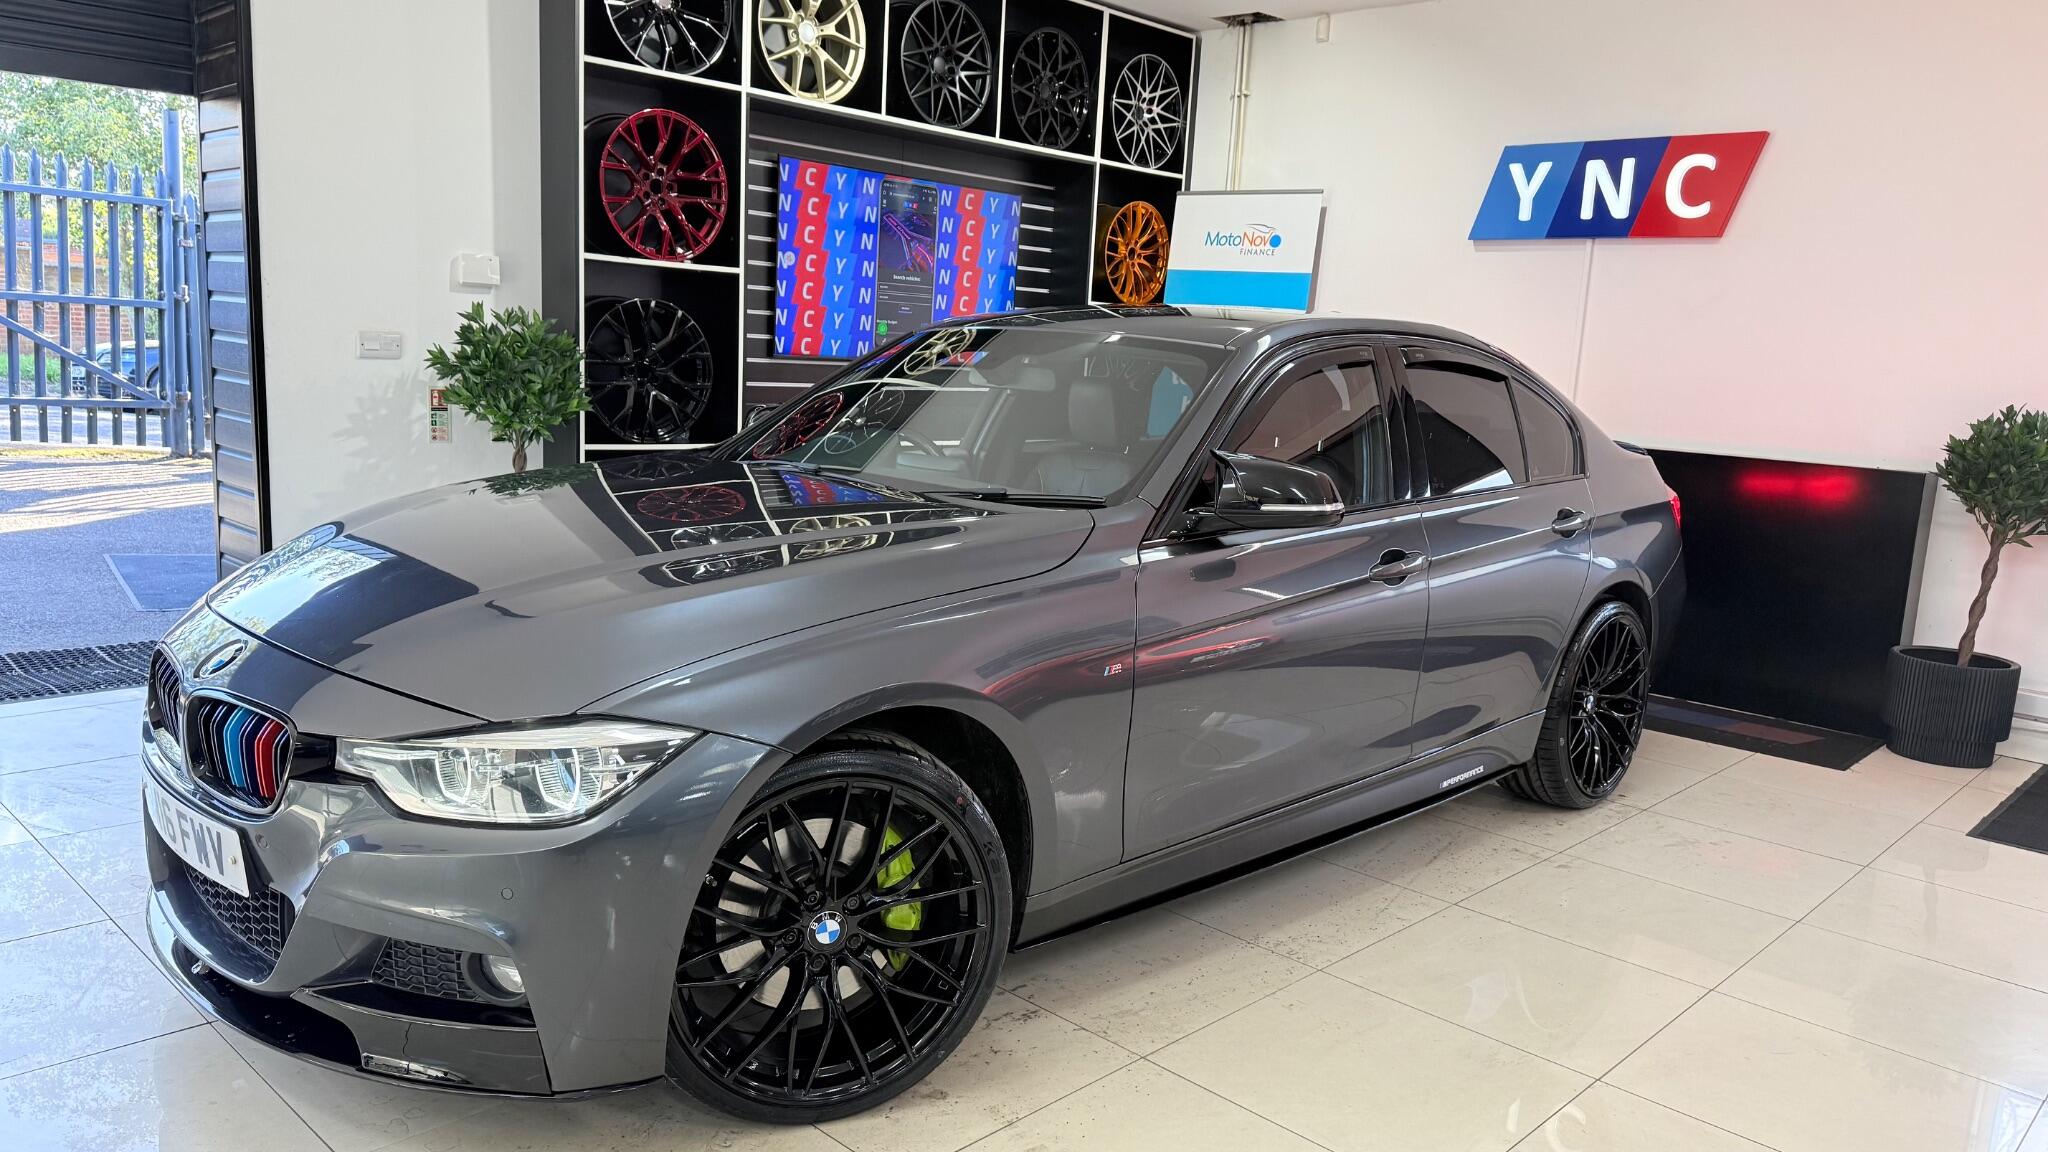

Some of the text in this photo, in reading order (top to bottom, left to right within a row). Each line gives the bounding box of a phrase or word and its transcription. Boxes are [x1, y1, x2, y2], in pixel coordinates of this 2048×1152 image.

[1508, 152, 1717, 222] YNC
[1204, 230, 1282, 248] MotoNovo
[1239, 248, 1276, 256] FINANCE
[810, 912, 842, 930] BMW
